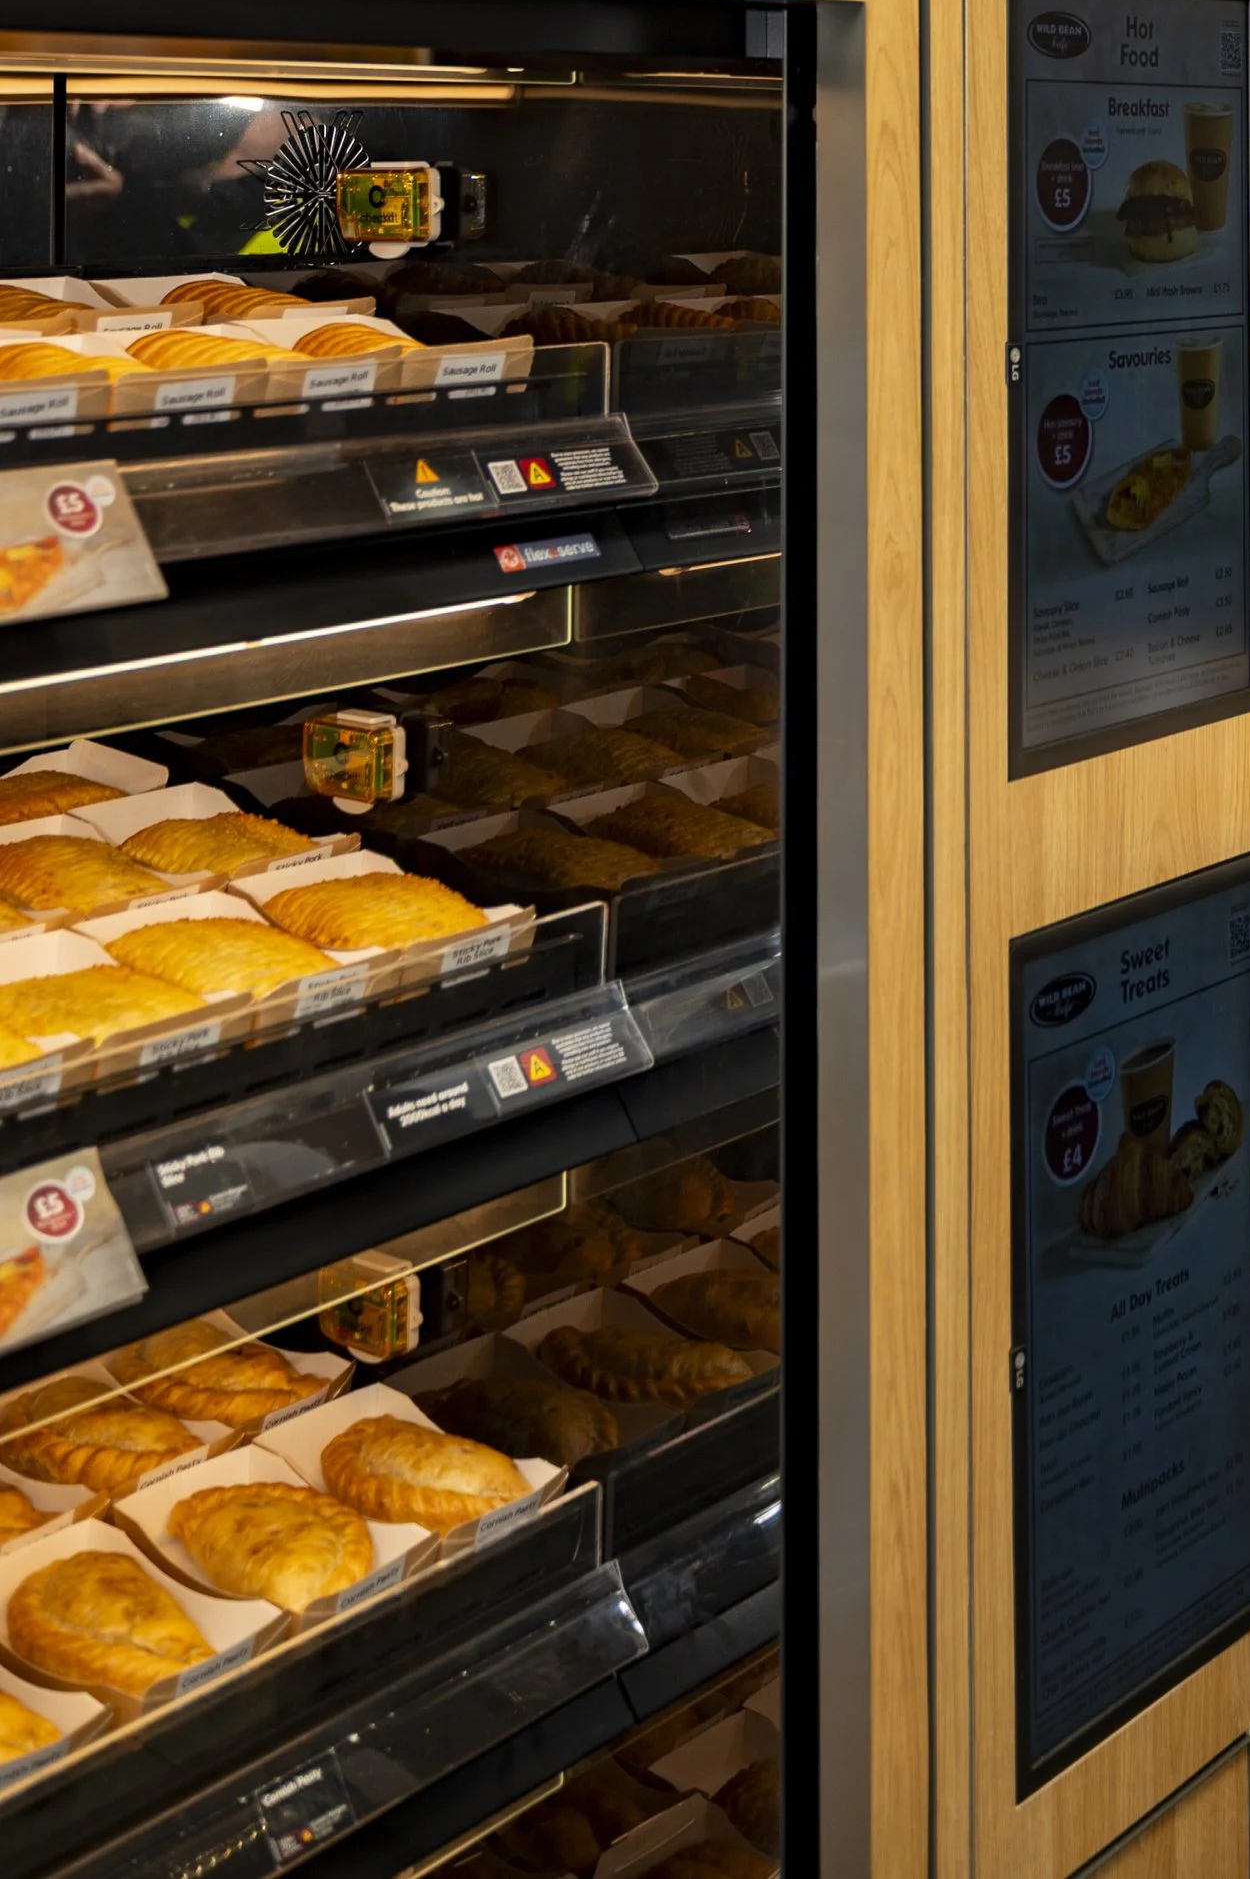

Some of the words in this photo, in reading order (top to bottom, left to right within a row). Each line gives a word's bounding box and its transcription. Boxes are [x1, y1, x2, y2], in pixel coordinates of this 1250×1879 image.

[1036, 24, 1056, 34] WILD
[1059, 25, 1082, 35] BEAN
[1126, 16, 1154, 39] Hot
[1120, 43, 1159, 67] Food
[1108, 97, 1170, 118] Breakfast
[1054, 188, 1071, 207] £5
[1108, 346, 1172, 369] Savouries
[309, 374, 350, 390] Sausage
[351, 370, 369, 382] Roll
[442, 365, 478, 378] Sausage
[479, 362, 497, 374] Roll
[0, 399, 45, 418] Sausage
[48, 396, 70, 410] Roll
[162, 391, 204, 406] Sausage
[206, 387, 226, 400] Roll
[1054, 444, 1071, 465] £5
[56, 492, 85, 515] £5
[391, 501, 417, 513] These
[418, 497, 453, 511] products
[469, 490, 484, 502] hot
[452, 942, 483, 959] Sticky
[1120, 936, 1170, 975] Sweet
[1038, 990, 1060, 1009] WILD
[1062, 981, 1086, 998] BEAN
[1120, 969, 1170, 1003] Treats
[1063, 1144, 1082, 1174] £4
[33, 1192, 65, 1219] £5
[1110, 1301, 1126, 1324] All
[1130, 1288, 1153, 1312] Day
[1155, 1266, 1190, 1296] Treats
[264, 1406, 298, 1430] Cornish
[299, 1398, 323, 1415] Pasty
[1121, 1459, 1186, 1511] Multipacks
[480, 1511, 514, 1532] Cornish
[514, 1501, 538, 1517] Pasty
